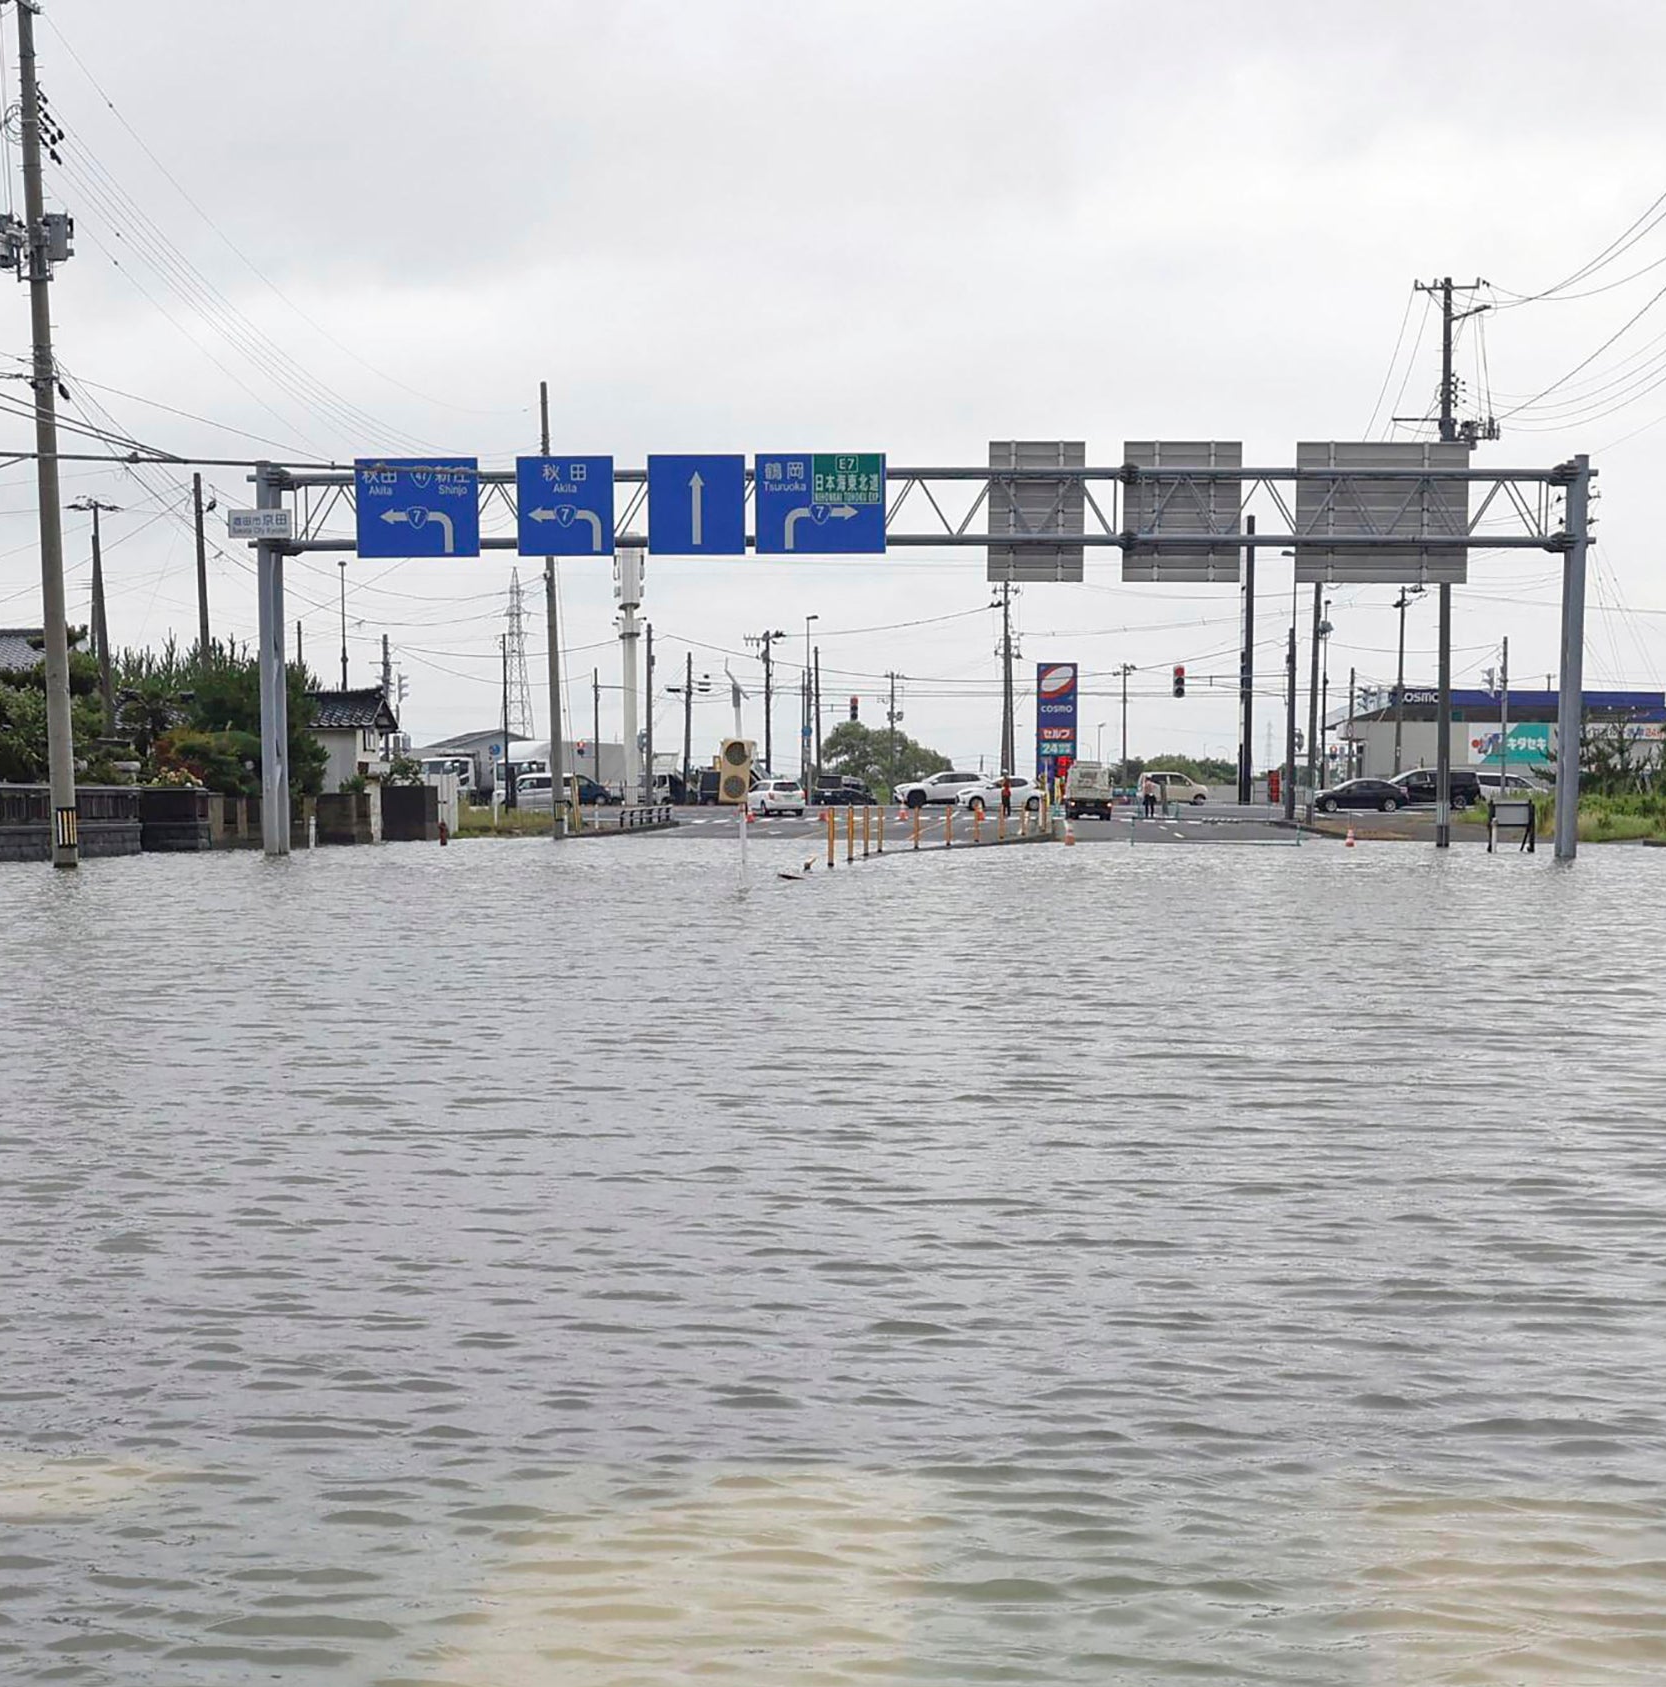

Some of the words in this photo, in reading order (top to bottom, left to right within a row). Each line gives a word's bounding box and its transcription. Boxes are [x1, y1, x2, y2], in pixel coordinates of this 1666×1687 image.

[838, 458, 855, 470] E7
[542, 464, 587, 481] 秋田
[764, 462, 804, 480] 鶴岡
[553, 483, 578, 494] Akita
[763, 482, 807, 493] Tsuruoka
[815, 473, 879, 492] 日本海東北道
[369, 485, 393, 496] Akita
[438, 485, 468, 497] Shinjo
[413, 510, 421, 523] 7
[561, 508, 570, 522] 7
[816, 506, 825, 519] 7
[1403, 691, 1439, 703] OSMO
[1041, 705, 1073, 713] COSMO
[1043, 729, 1071, 740] セルフ
[1507, 736, 1547, 751] キタセキ
